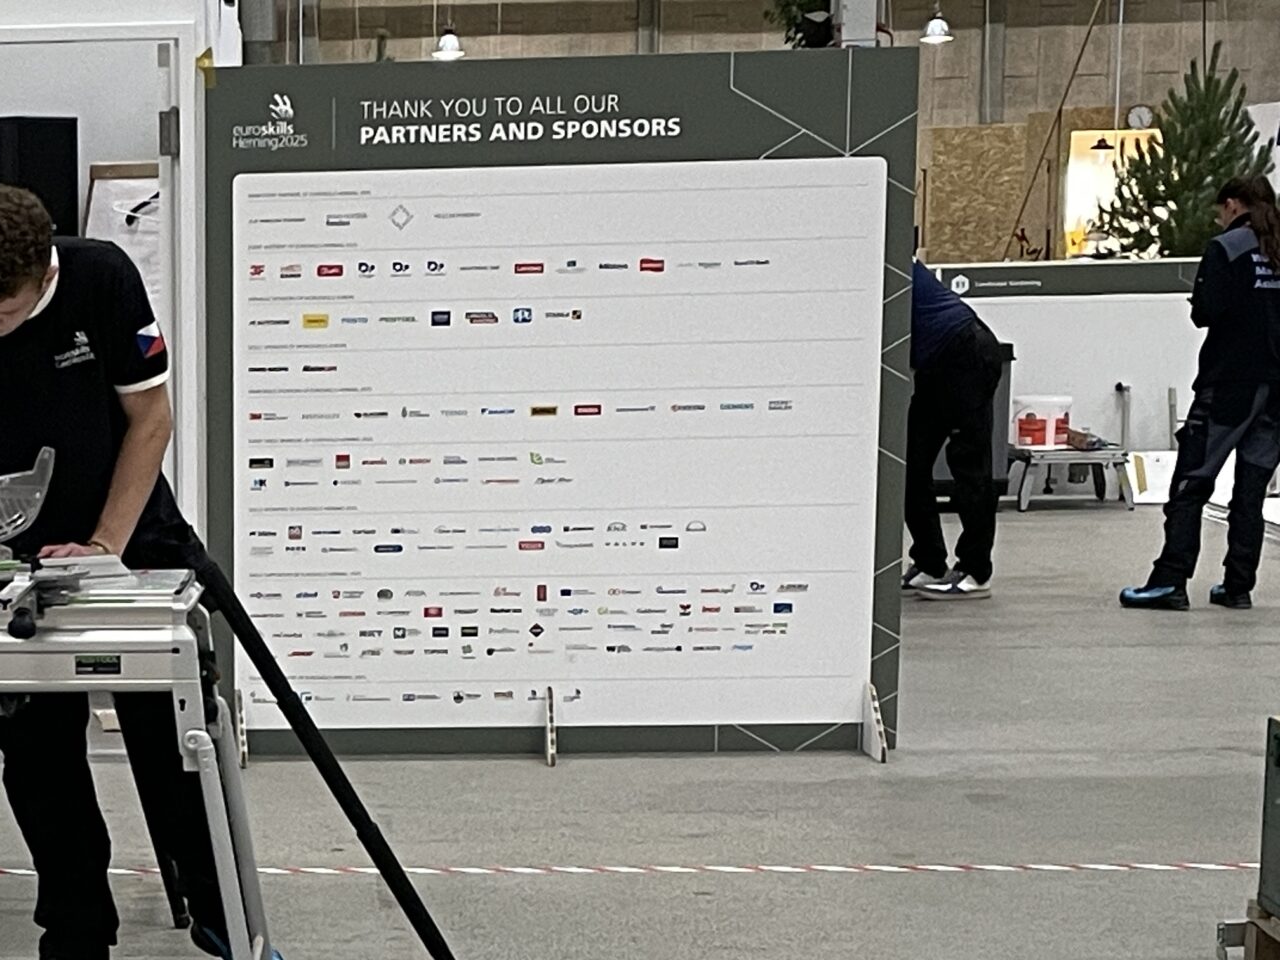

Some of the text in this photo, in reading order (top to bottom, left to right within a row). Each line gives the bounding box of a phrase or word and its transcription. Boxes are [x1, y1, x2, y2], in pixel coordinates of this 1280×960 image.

[360, 94, 620, 120] THANK YOU TO ALL OUR
[232, 121, 295, 136] euroskills
[360, 117, 681, 145] PARTNERS AND SPONSORS
[232, 134, 308, 151] Herning2025
